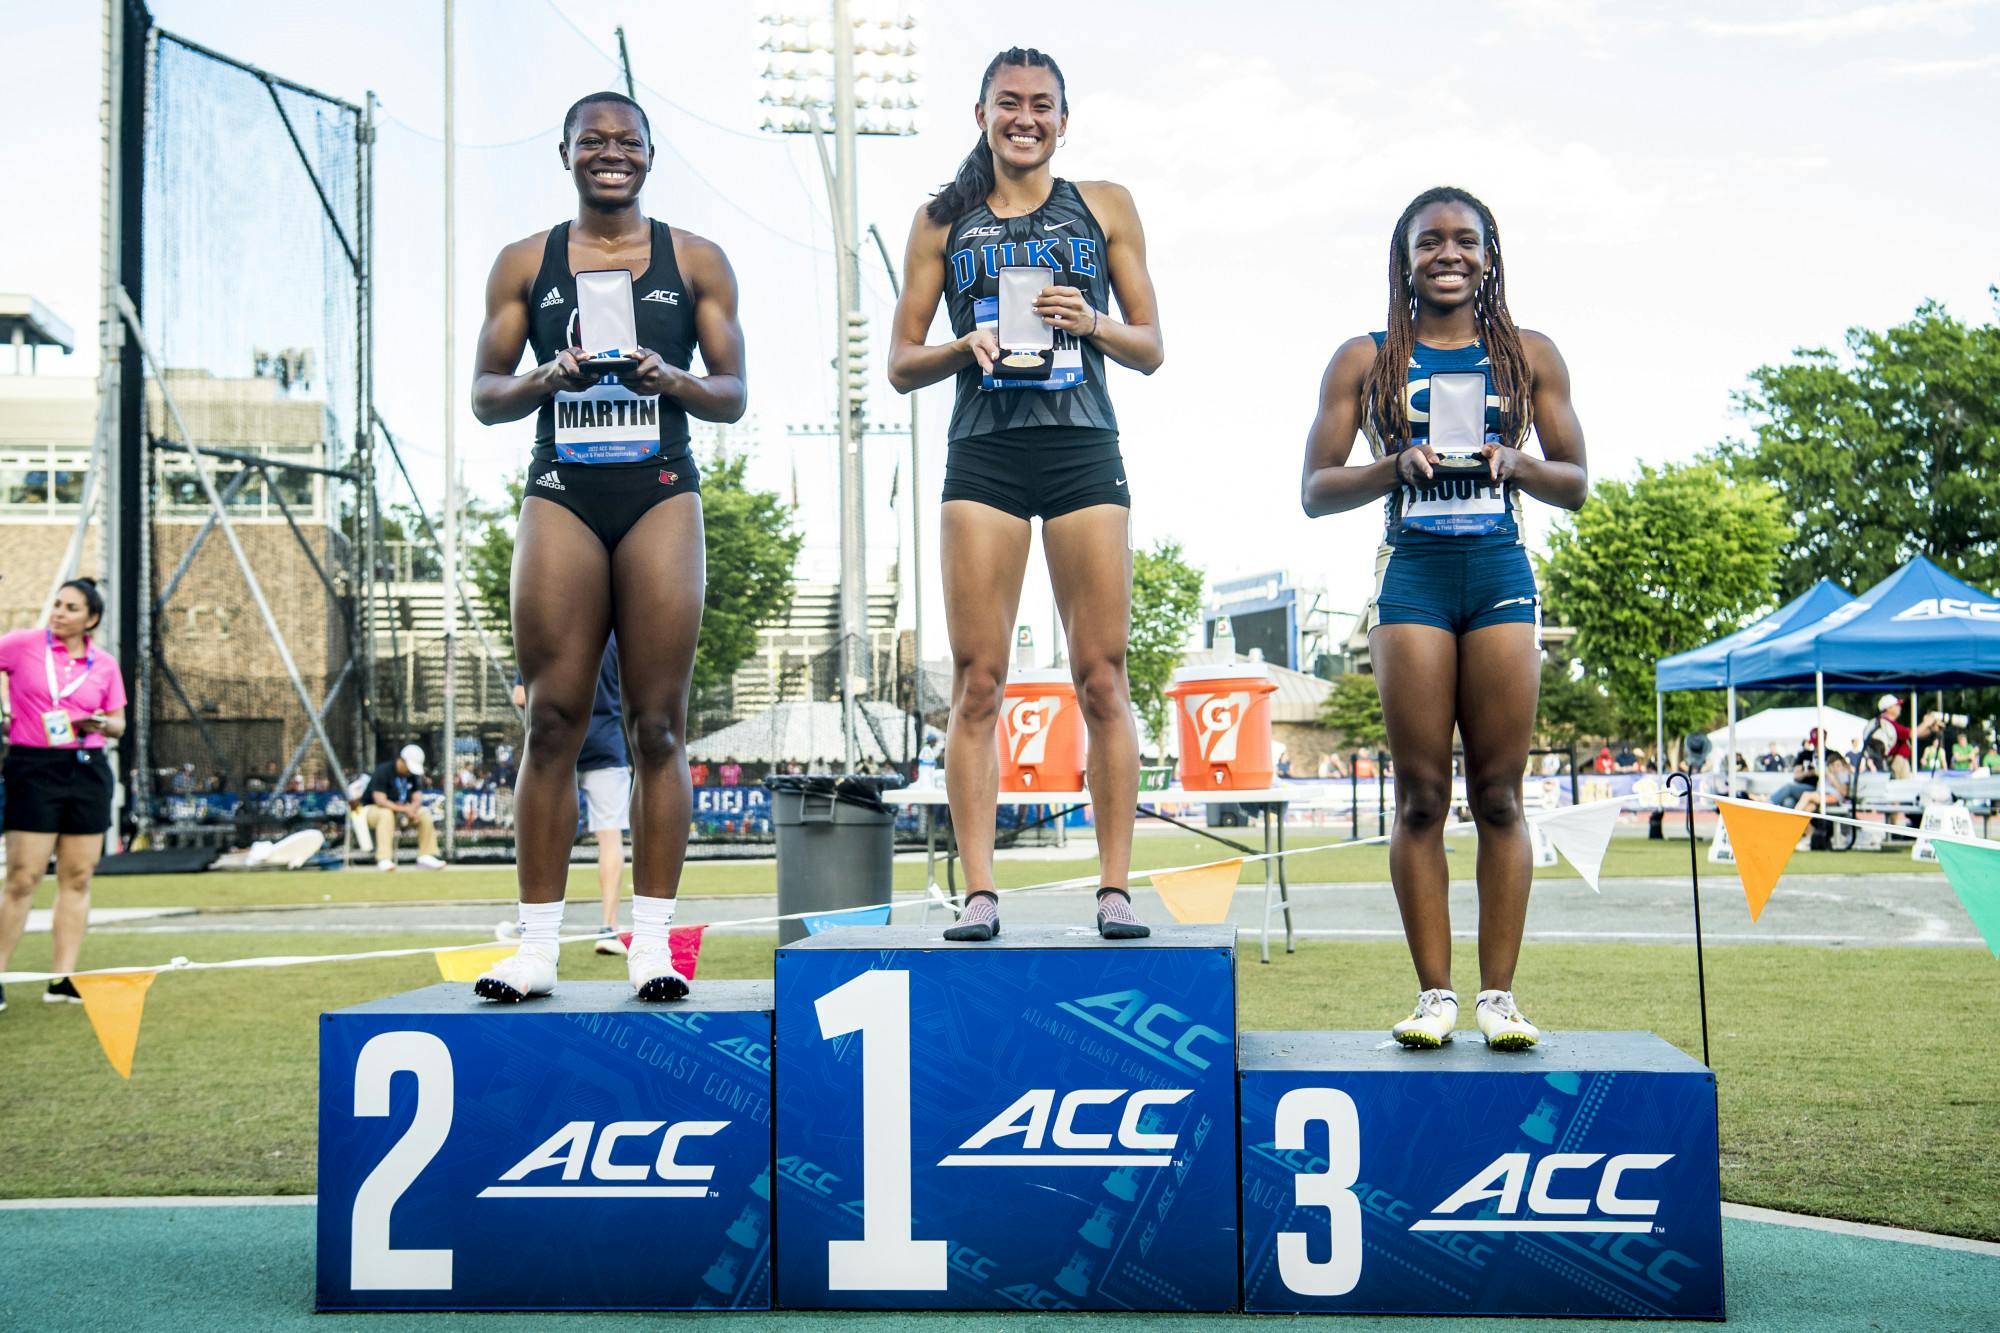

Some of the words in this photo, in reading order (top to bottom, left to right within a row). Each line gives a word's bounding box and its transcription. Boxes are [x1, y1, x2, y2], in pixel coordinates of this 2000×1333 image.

[961, 226, 1003, 236] ACC
[951, 237, 1096, 294] DUKE
[541, 297, 564, 309] adidas
[645, 289, 680, 303] ACC
[558, 399, 656, 429] MARTIN
[536, 479, 566, 491] adidas
[1896, 598, 2000, 619] ACC
[1021, 1007, 1076, 1046] ATLANTIC
[1079, 1036, 1120, 1066] COAST
[1074, 989, 1233, 1070] ACC
[636, 1036, 700, 1084] COAST
[813, 969, 947, 1290] 1
[958, 1089, 1195, 1149] ACC
[351, 1031, 454, 1290] 2
[498, 1121, 732, 1180] ACC
[1275, 1088, 1362, 1296] 3
[1430, 1153, 1675, 1215] ACC
